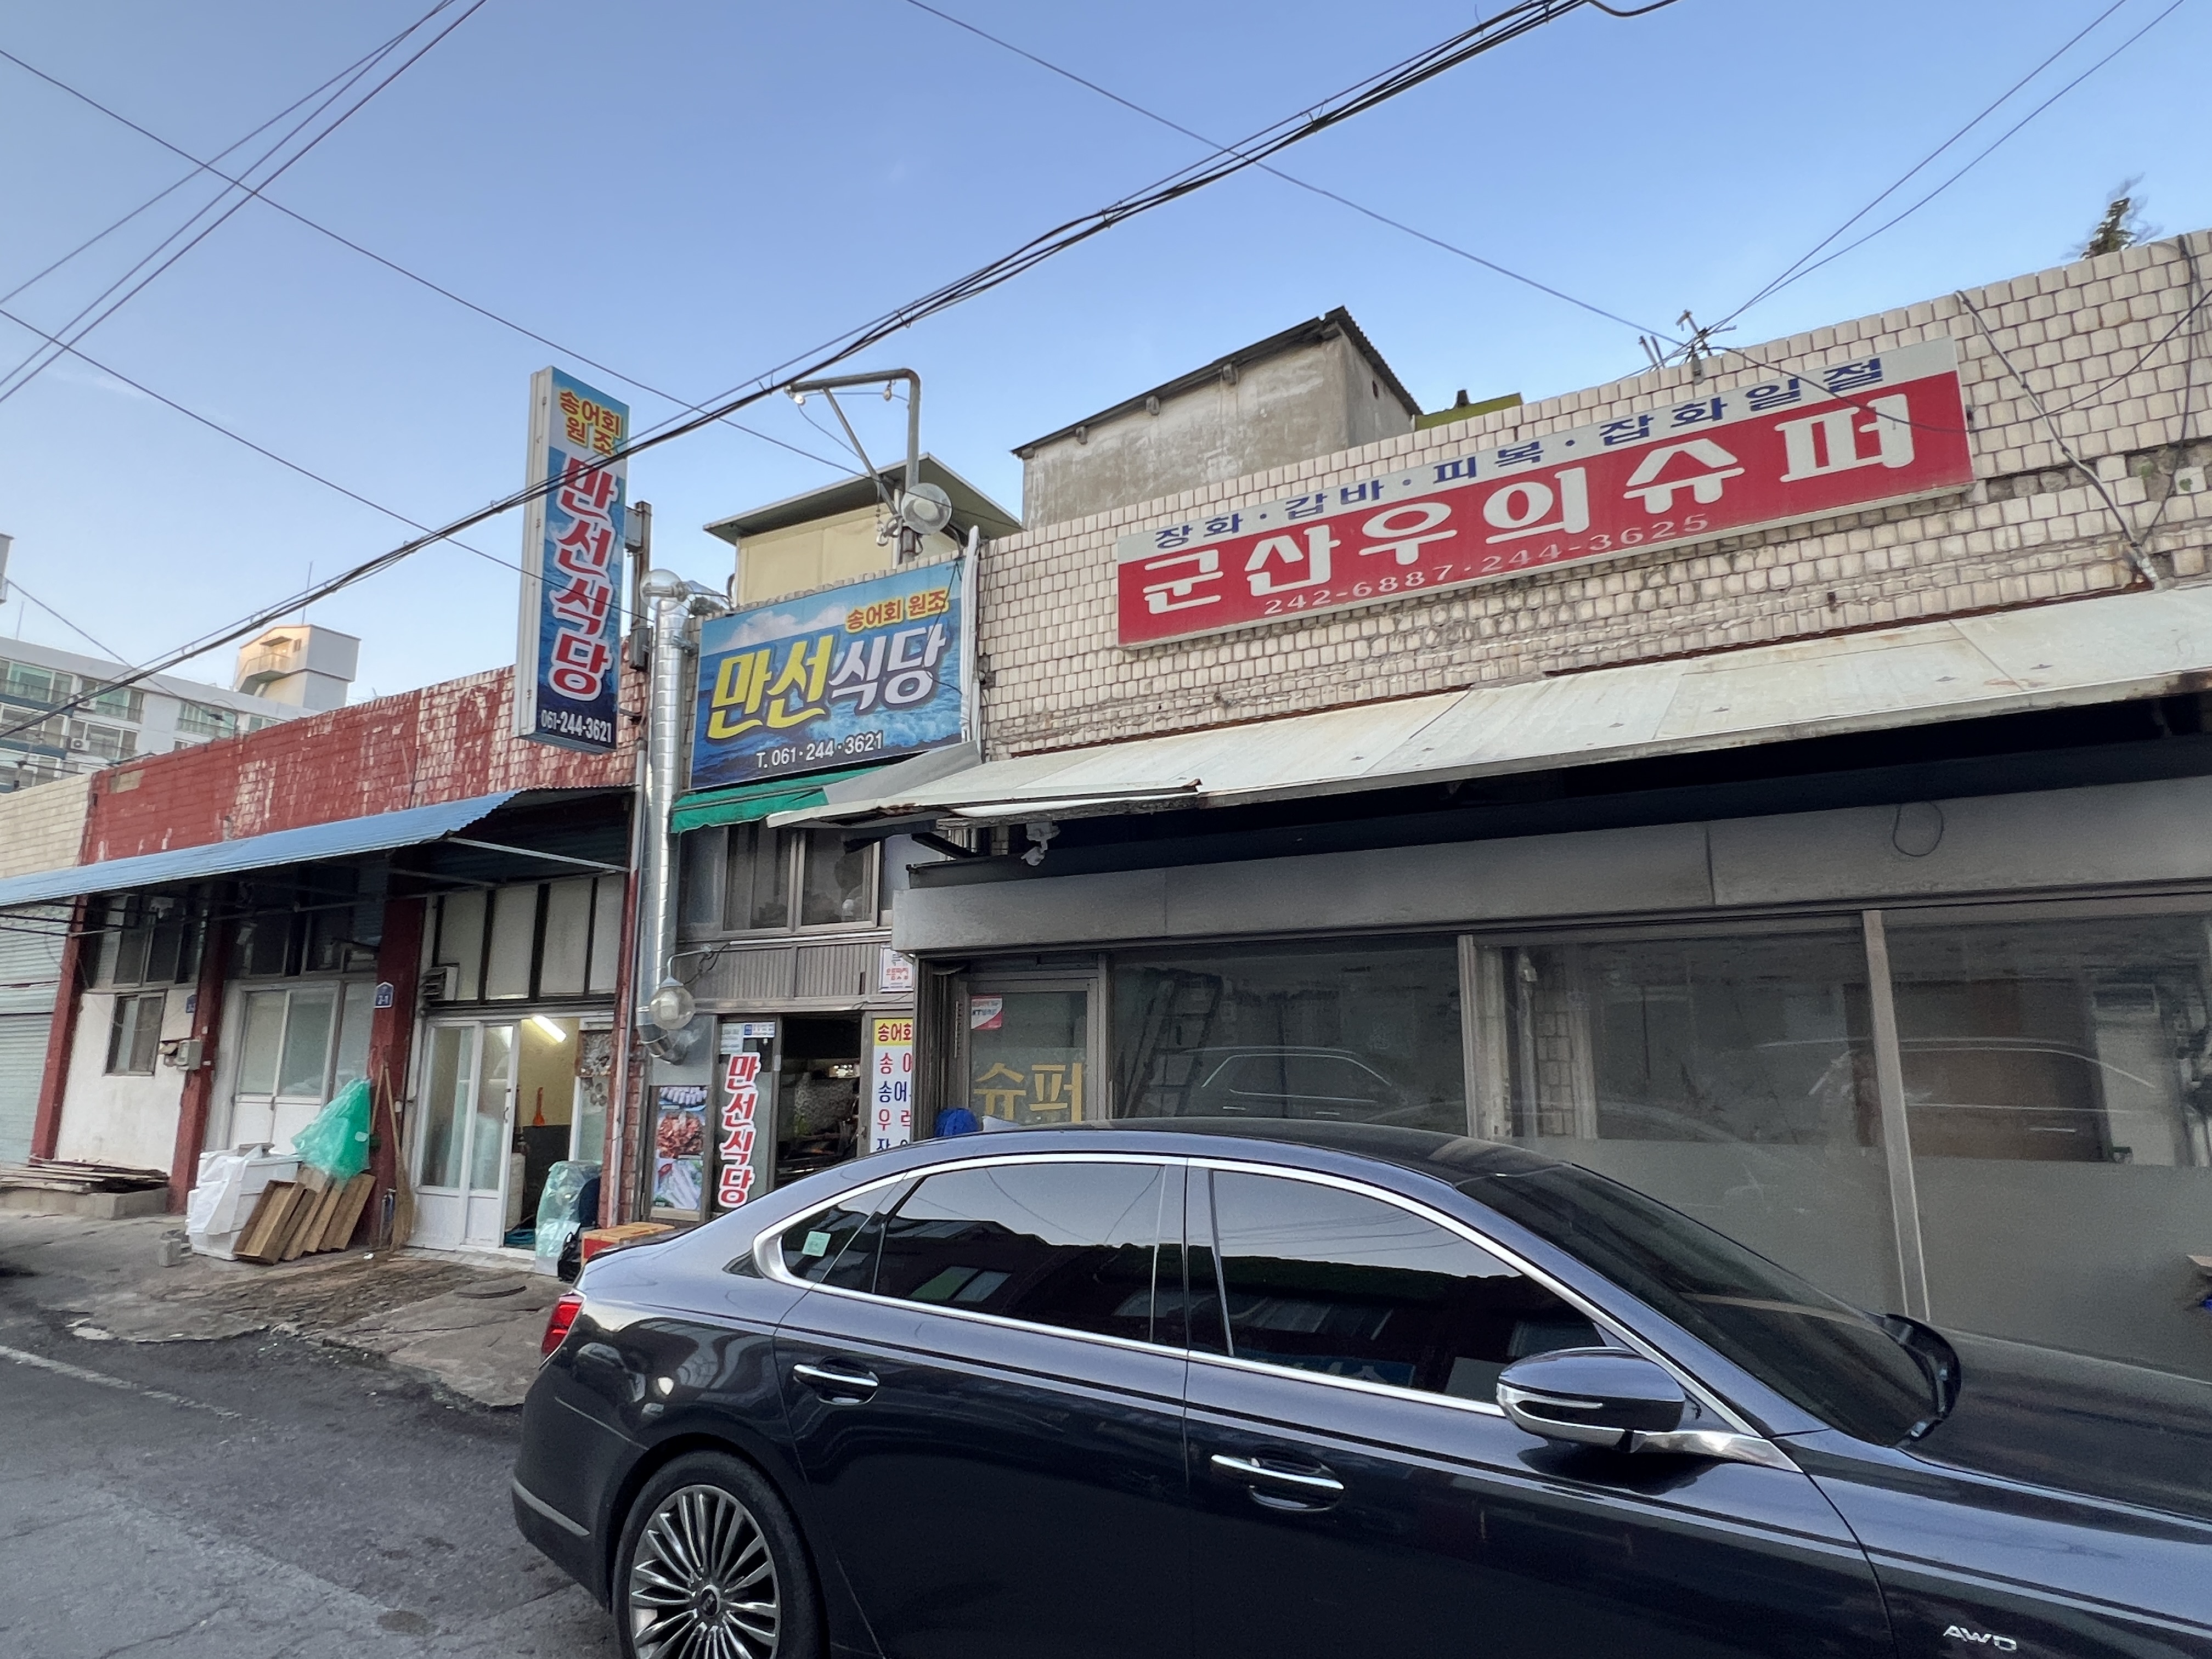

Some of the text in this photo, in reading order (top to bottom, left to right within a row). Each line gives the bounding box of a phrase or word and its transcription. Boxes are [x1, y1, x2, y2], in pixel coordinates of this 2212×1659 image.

[560, 391, 619, 437] 송어회
[566, 417, 613, 457] 원조
[1142, 393, 1915, 614] 군산우의슈퍼
[554, 457, 615, 696] 만선식당
[847, 590, 948, 630] 송어회 원조
[707, 623, 946, 740] 만선식당
[540, 709, 612, 743] 061-244-3621
[878, 1080, 911, 1103] 송어
[973, 1062, 1082, 1124] 슈퍼
[720, 1055, 759, 1204] 만선식당
[1943, 1625, 2017, 1651] AWD
